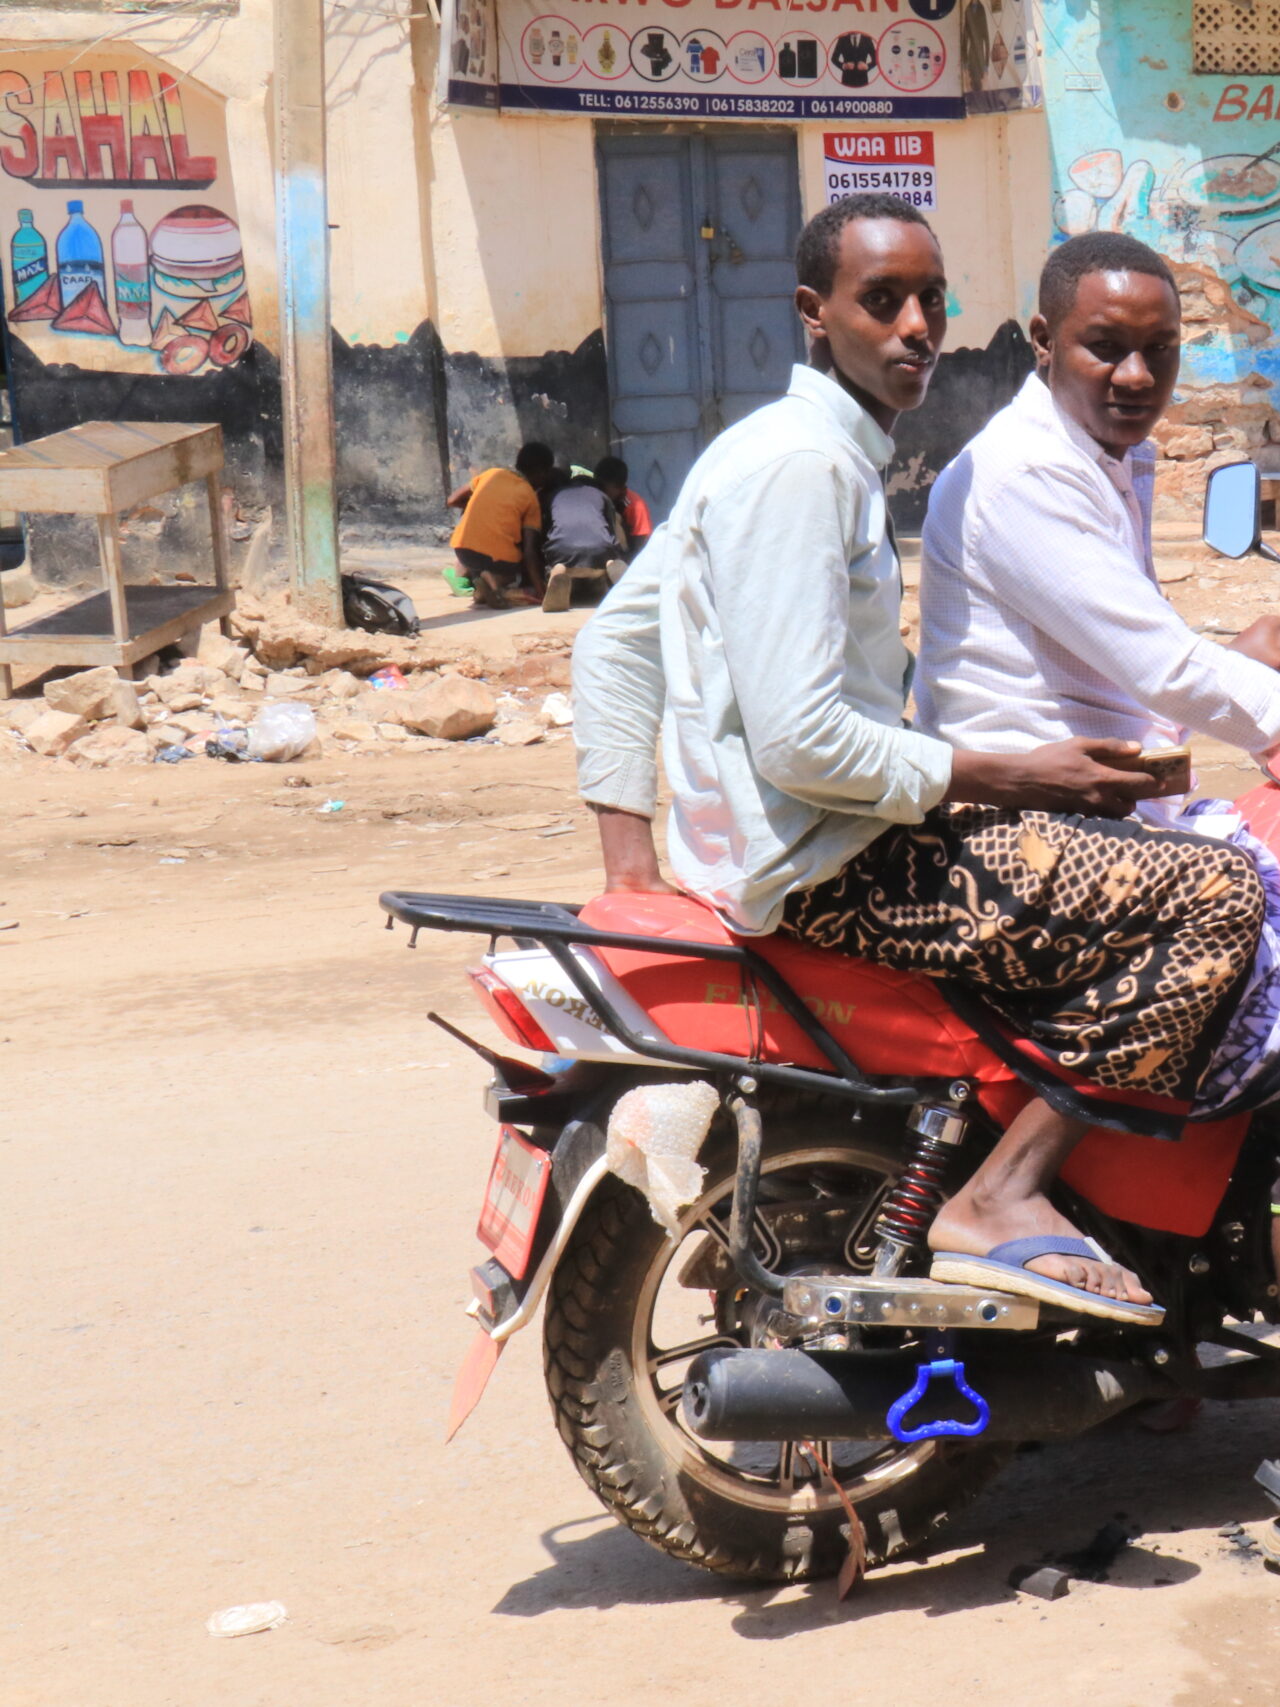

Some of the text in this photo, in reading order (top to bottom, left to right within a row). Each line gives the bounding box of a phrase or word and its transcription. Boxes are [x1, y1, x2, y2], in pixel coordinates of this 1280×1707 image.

[578, 93, 893, 113] TELL: 0612556390 0615838202 0614900880
[0, 70, 217, 180] SAHAL
[833, 135, 922, 157] WAA IIB
[828, 171, 933, 189] 0615541789
[17, 261, 45, 282] MAX
[522, 979, 614, 1036] EKON
